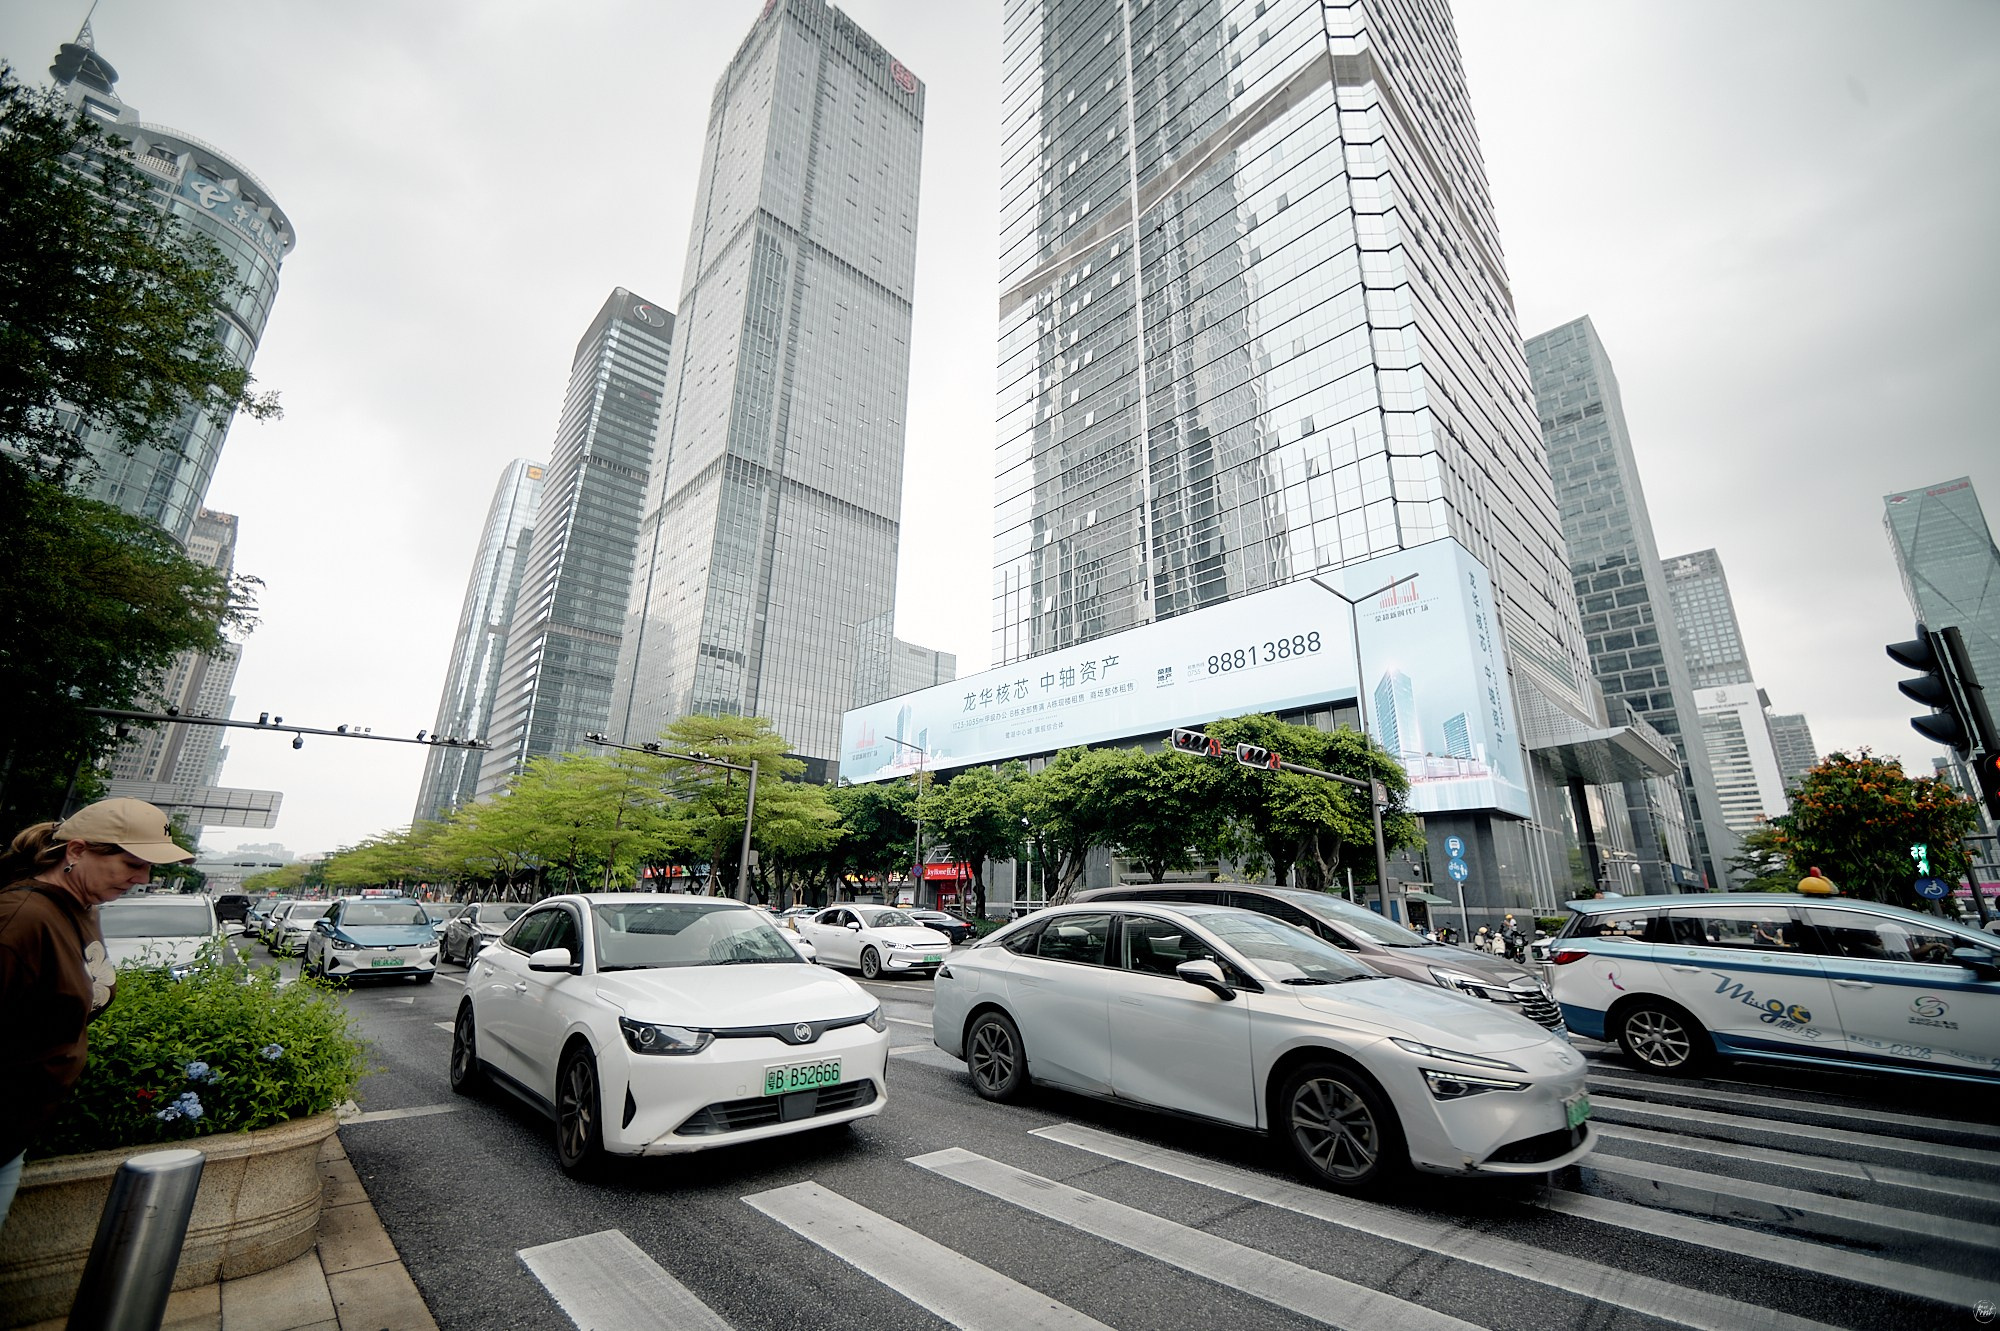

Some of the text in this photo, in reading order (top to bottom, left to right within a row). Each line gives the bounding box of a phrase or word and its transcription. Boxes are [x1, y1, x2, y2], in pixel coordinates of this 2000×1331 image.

[228, 217, 255, 241] CHINA
[232, 205, 281, 260] 中国电信
[962, 655, 1119, 713] 龙华核芯 中轴资产
[790, 1062, 840, 1088] B52666
